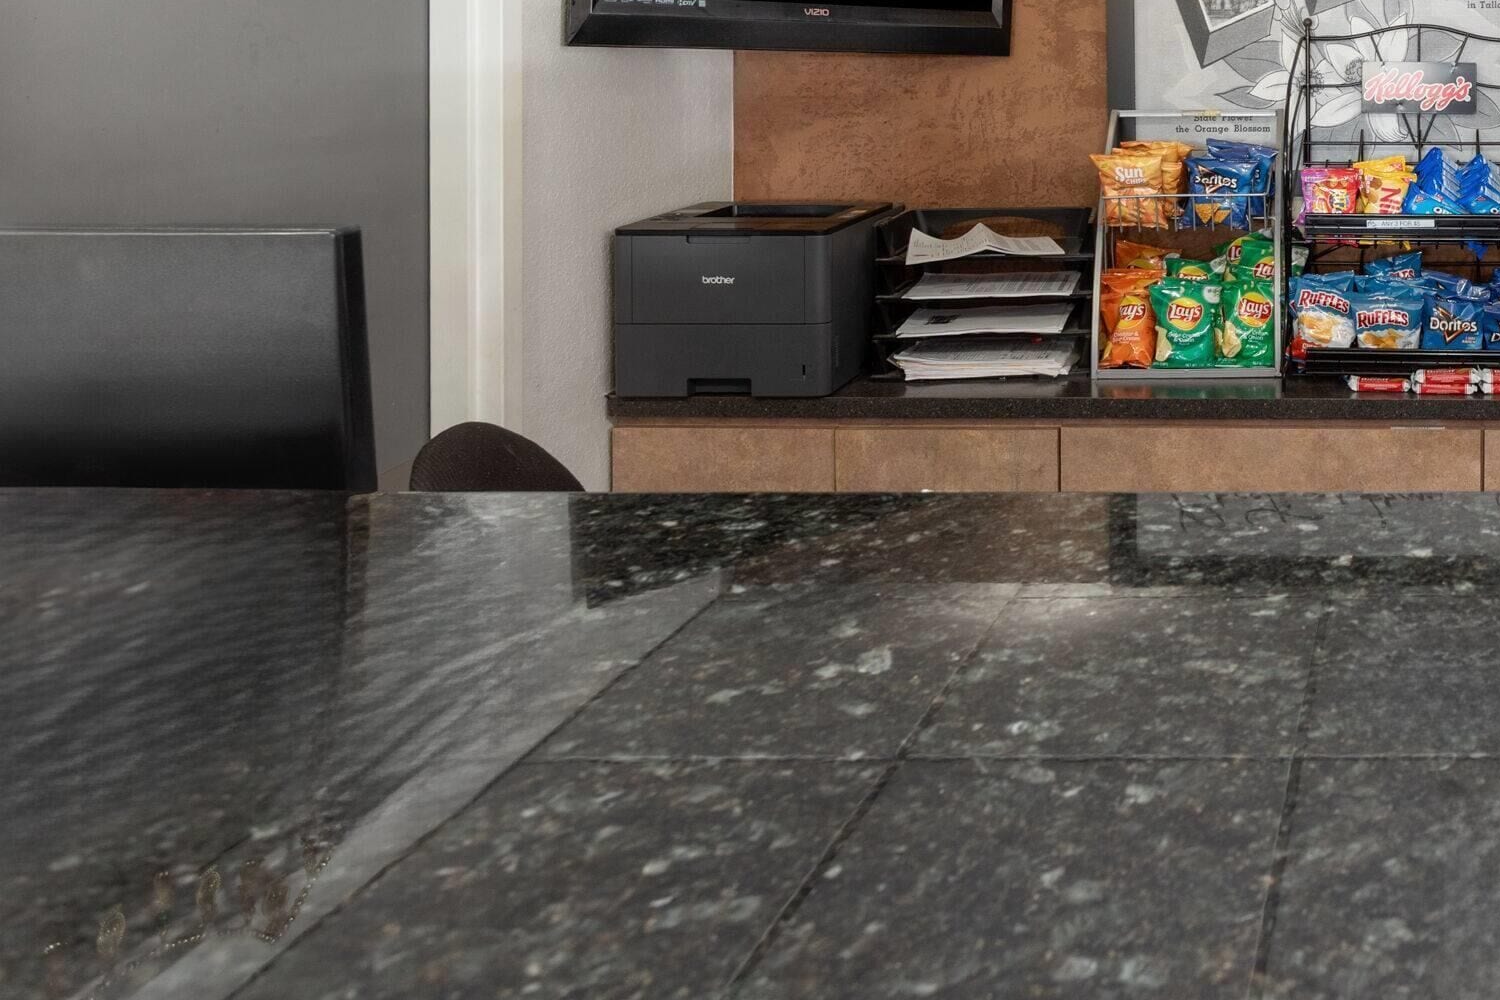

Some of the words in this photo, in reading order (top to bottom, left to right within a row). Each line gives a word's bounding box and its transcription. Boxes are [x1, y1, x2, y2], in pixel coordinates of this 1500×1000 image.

[803, 7, 830, 17] VIZIO
[1467, 1, 1476, 9] in
[1364, 67, 1473, 111] Kellogg's
[1175, 125, 1190, 133] the
[1194, 125, 1229, 134] Orange
[1233, 124, 1271, 133] Blossom
[1115, 166, 1144, 183] Sun
[701, 275, 735, 286] brother
[1298, 289, 1350, 314] RUFFLES
[1357, 310, 1409, 328] RUFFLES
[1429, 316, 1478, 332] Doritos
